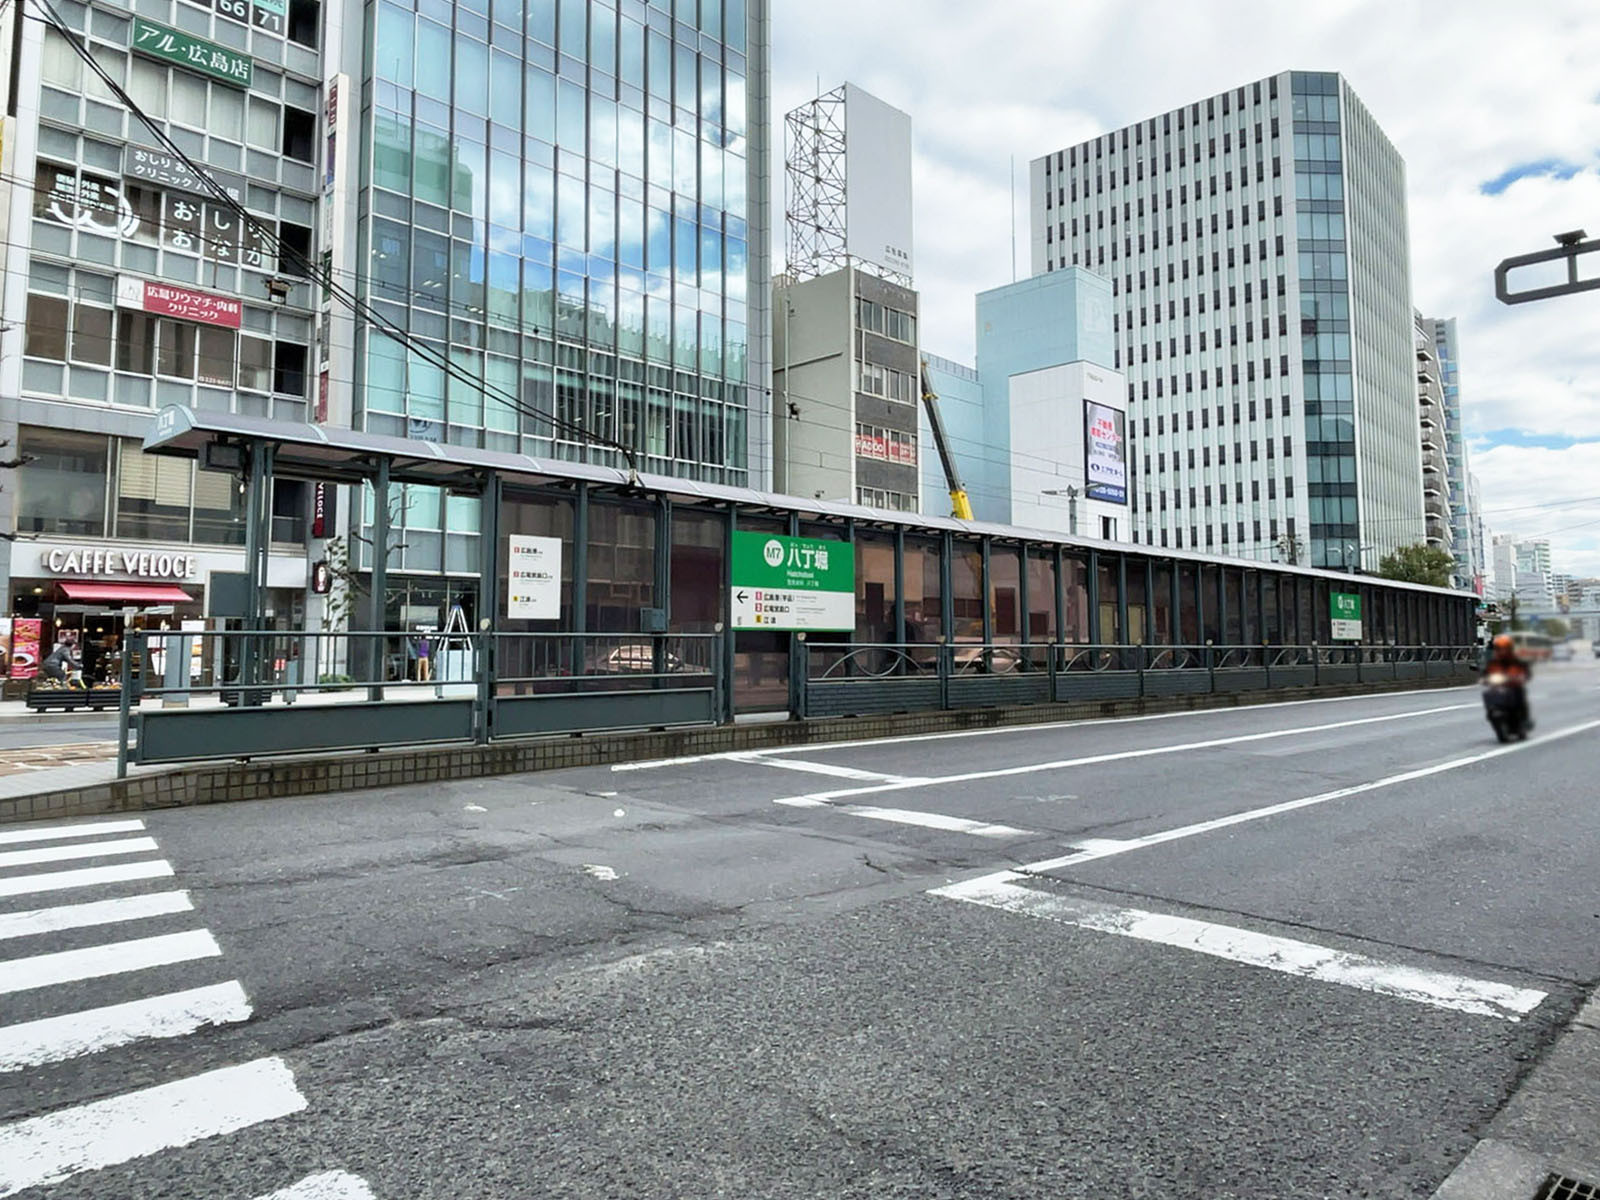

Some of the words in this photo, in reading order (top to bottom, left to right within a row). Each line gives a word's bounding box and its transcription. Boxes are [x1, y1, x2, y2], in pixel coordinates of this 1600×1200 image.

[258, 9, 280, 31] 71
[137, 25, 249, 79] アル・広島店
[168, 302, 218, 320] クリニック
[49, 549, 116, 575] CAFFE
[121, 552, 196, 579] VELOCE
[766, 546, 781, 560] M7
[787, 547, 828, 571] 八丁堀
